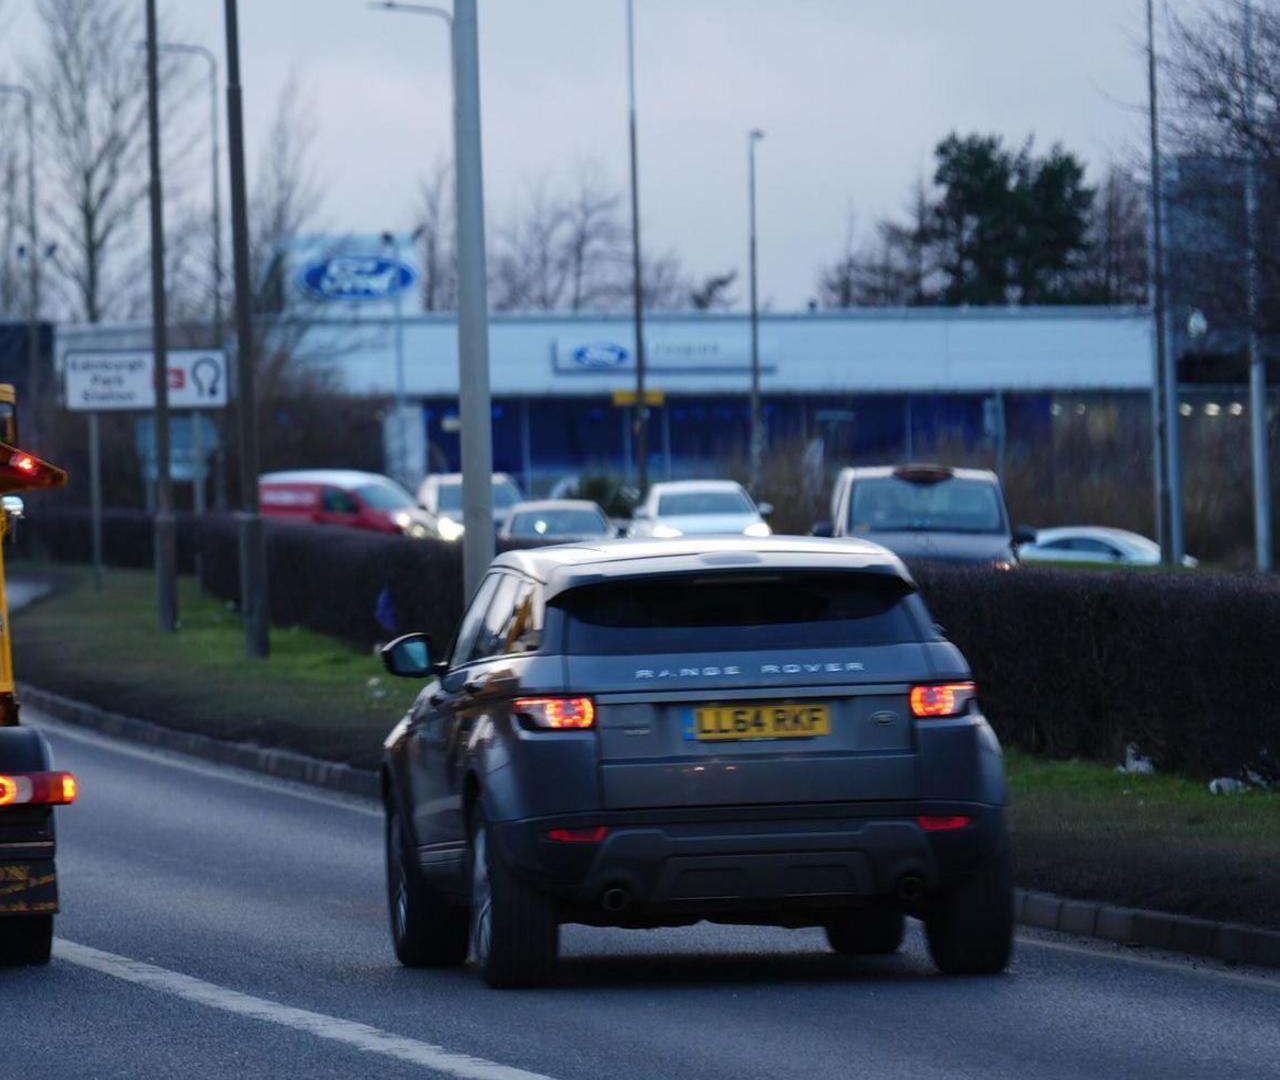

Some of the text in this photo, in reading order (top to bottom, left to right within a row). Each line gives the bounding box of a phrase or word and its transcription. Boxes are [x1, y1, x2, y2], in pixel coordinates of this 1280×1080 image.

[635, 662, 864, 678] RANGE ROVER
[696, 707, 824, 734] LL64 RKF
